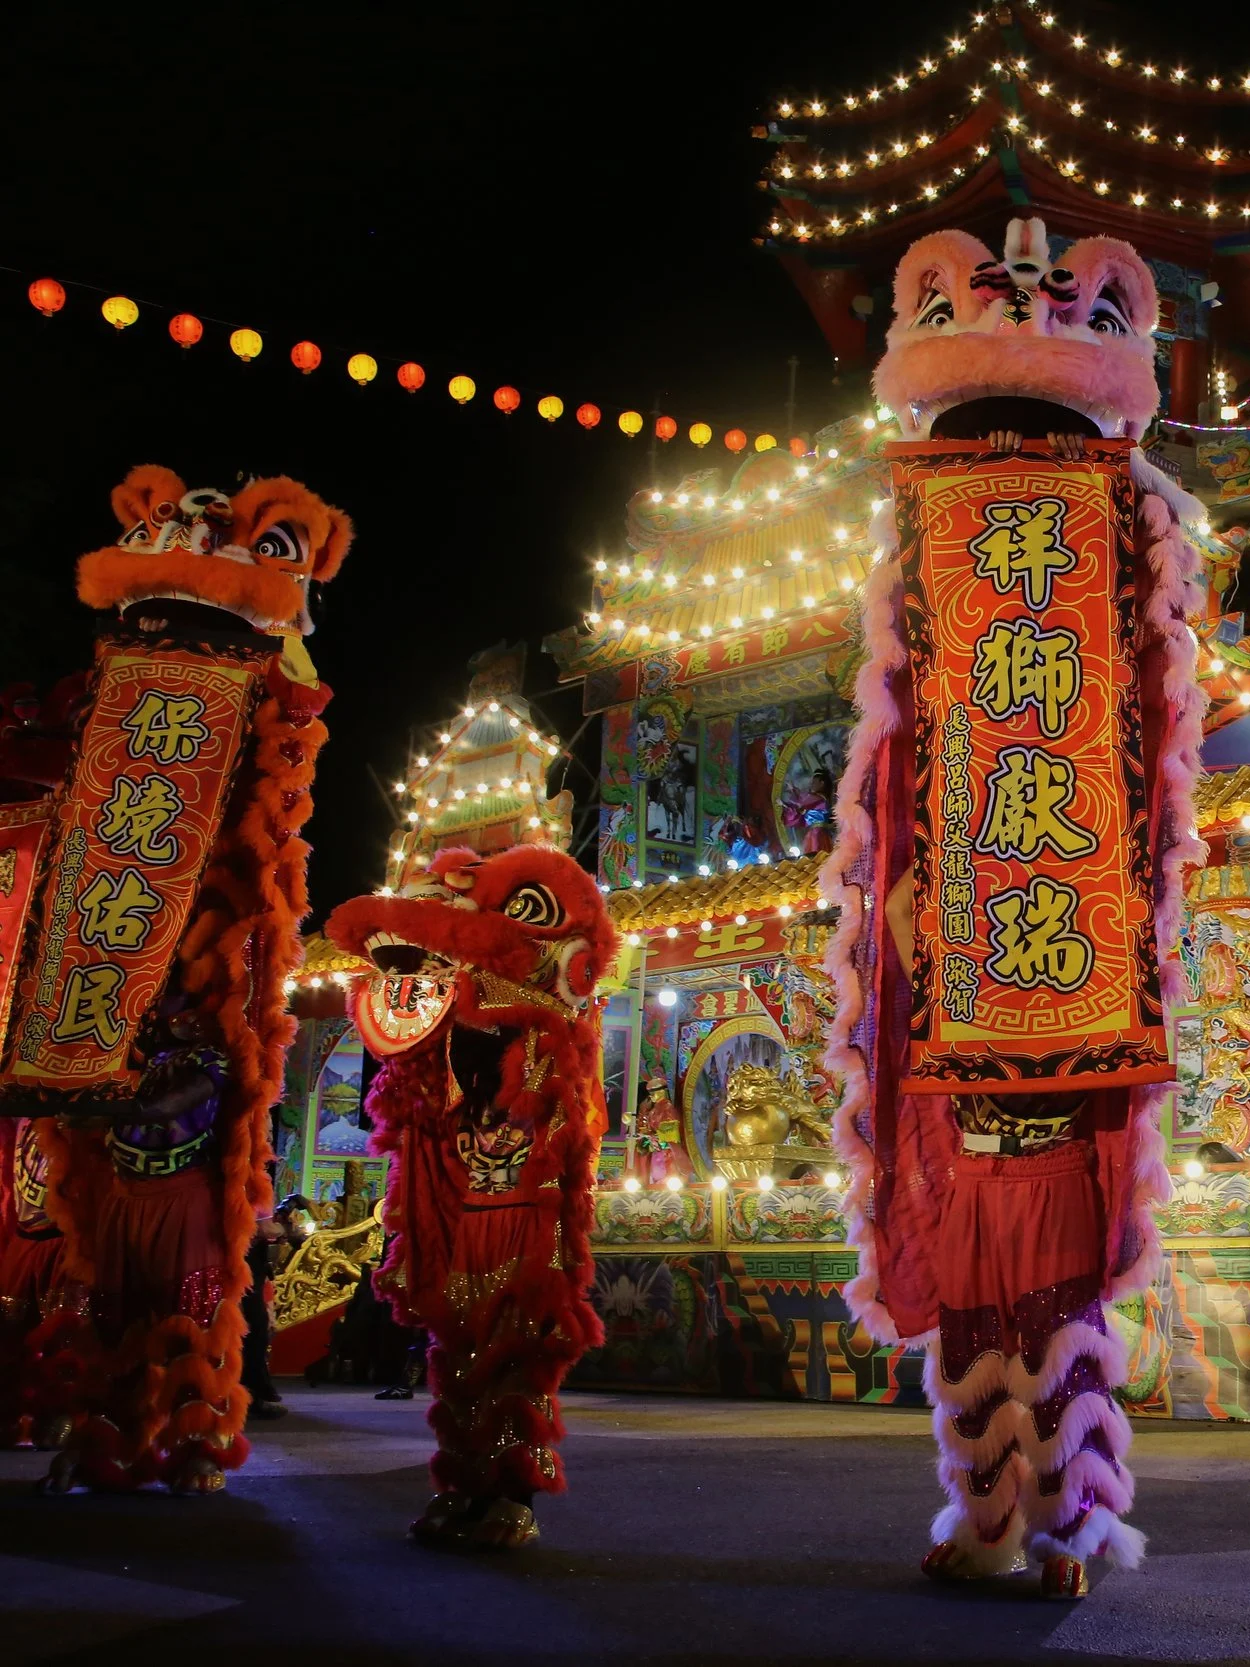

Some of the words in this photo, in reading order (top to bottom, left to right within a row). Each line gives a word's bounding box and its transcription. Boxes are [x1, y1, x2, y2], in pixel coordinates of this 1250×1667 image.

[941, 703, 974, 944] 長興呂師父龍獅團
[968, 497, 1099, 993] 祥獅獻瑞
[36, 828, 88, 1007] 長興呂師父龍獅團
[51, 688, 210, 1052] 保境佑民
[19, 1011, 50, 1063] 敬賀
[941, 953, 978, 1022] 敬賀
